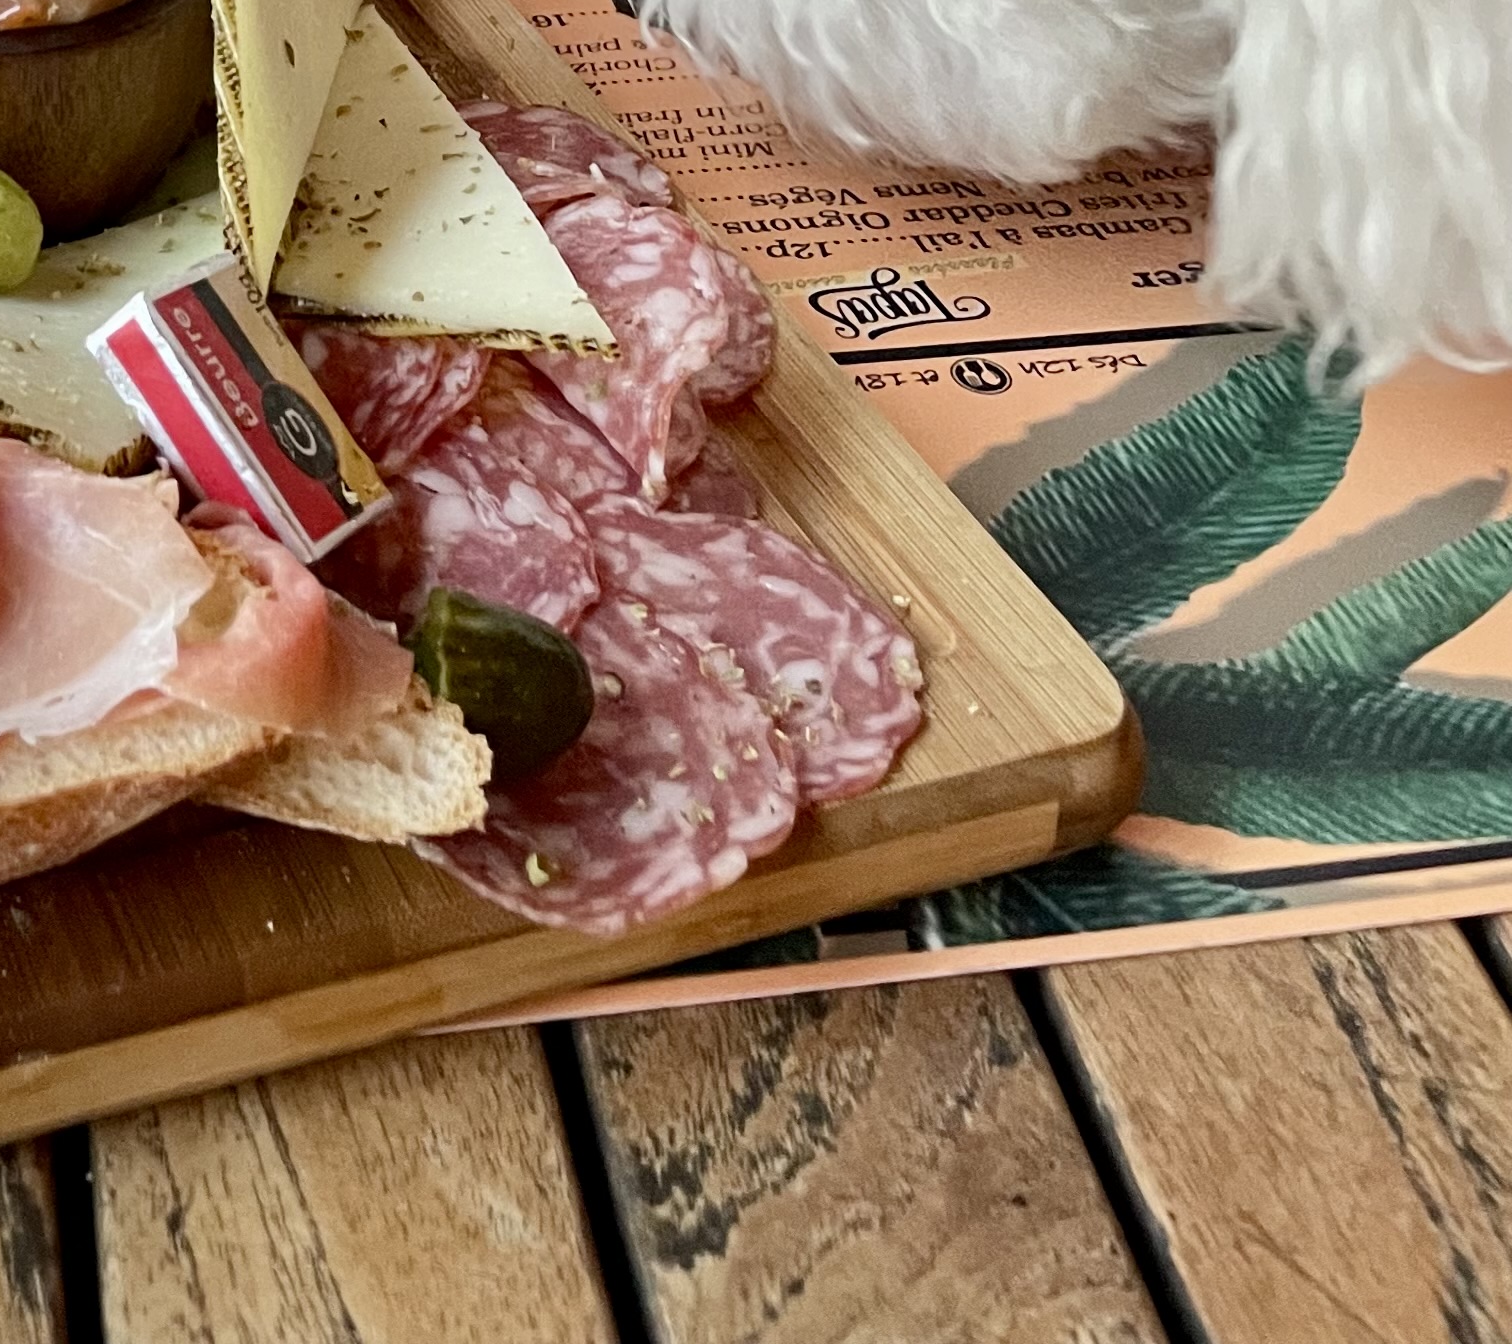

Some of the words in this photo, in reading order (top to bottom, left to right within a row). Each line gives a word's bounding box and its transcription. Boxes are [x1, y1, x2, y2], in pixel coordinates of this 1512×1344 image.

[528, 13, 569, 28] 16
[553, 37, 622, 58] pain
[696, 140, 775, 161] Mini
[748, 186, 868, 210] Végés
[873, 180, 986, 200] Nems
[903, 200, 1073, 225] Cheddar
[996, 228, 1023, 246] à
[1031, 216, 1193, 241] Gambas
[808, 267, 992, 341] Tapas
[1017, 357, 1083, 379] 12h
[1087, 353, 1147, 374] Dés
[909, 369, 940, 386] et
